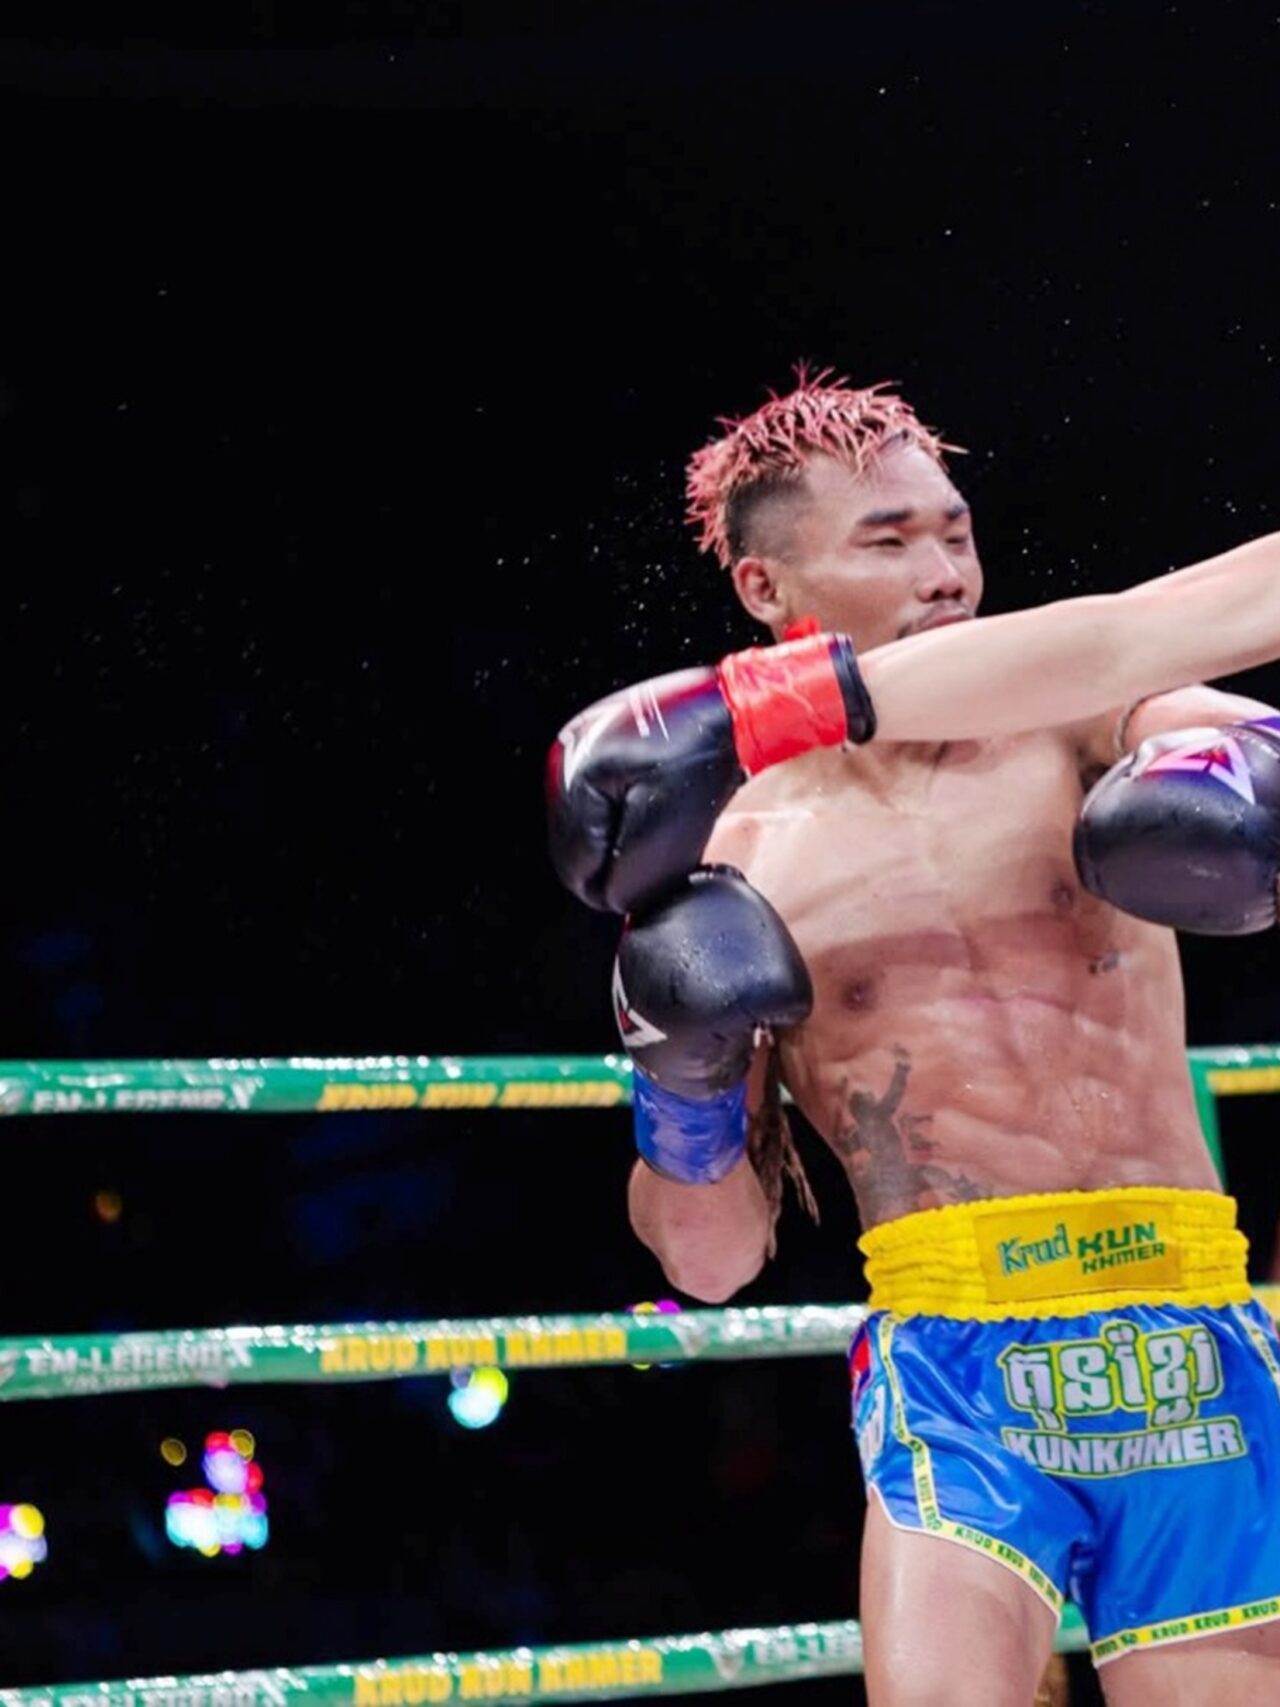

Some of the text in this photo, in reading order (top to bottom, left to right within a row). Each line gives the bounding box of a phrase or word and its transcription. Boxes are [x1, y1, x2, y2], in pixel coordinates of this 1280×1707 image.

[998, 1221, 1156, 1279] Krud KUN
[1082, 1242, 1165, 1275] KHMER
[1005, 1421, 1240, 1474] KUNKHMER
[1151, 1622, 1189, 1641] KRUD
[1193, 1611, 1230, 1631] KRUD
[1242, 1601, 1279, 1619] KRUD
